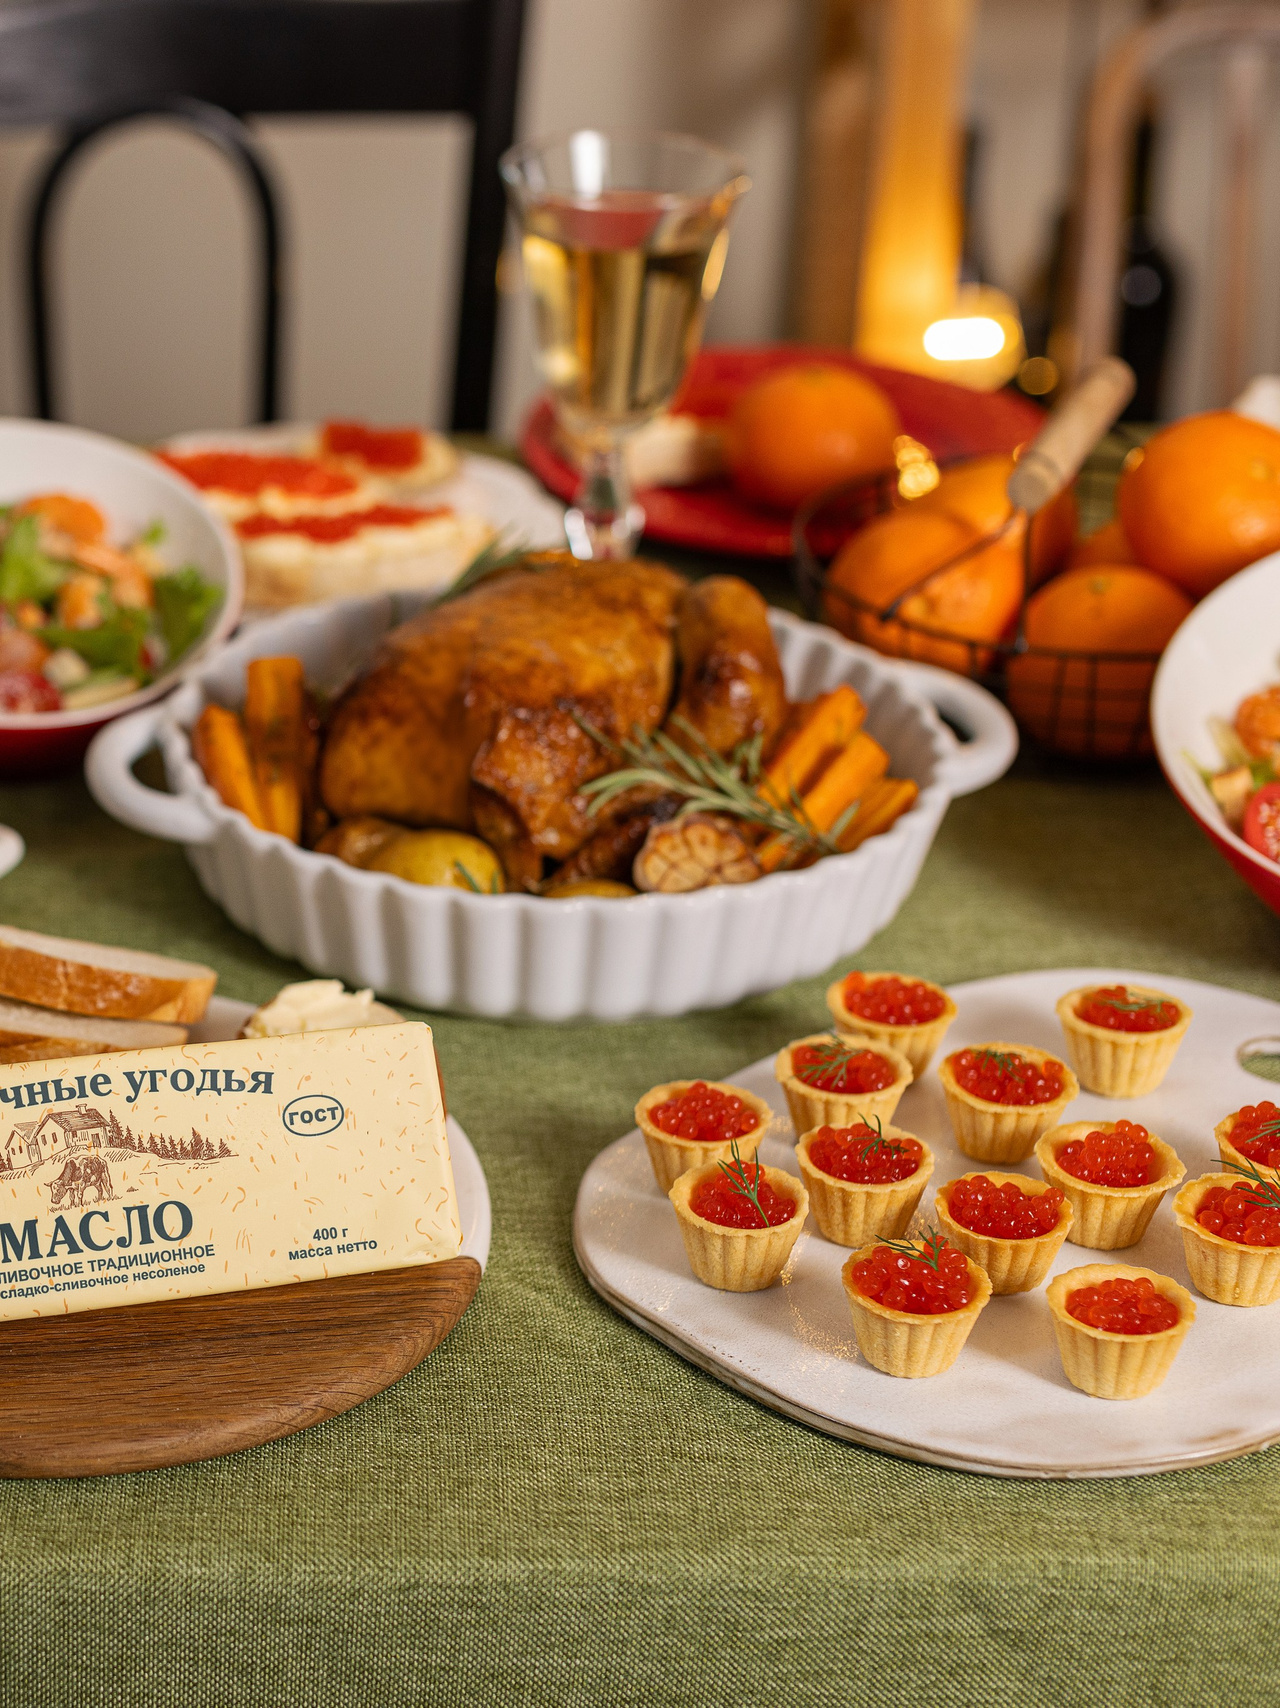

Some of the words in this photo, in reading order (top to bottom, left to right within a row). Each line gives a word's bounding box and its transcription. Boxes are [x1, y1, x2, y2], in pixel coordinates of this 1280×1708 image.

[122, 1068, 274, 1104] угодья
[287, 1106, 339, 1126] ГОСТ
[312, 1227, 338, 1241] 400
[341, 1228, 348, 1238] г
[87, 1243, 216, 1274] ТРАДИЦИОННОЕ
[288, 1244, 333, 1261] масса
[336, 1239, 378, 1255] нетто
[0, 1272, 130, 1300] сладко-сливочное
[132, 1264, 206, 1283] несоленое
